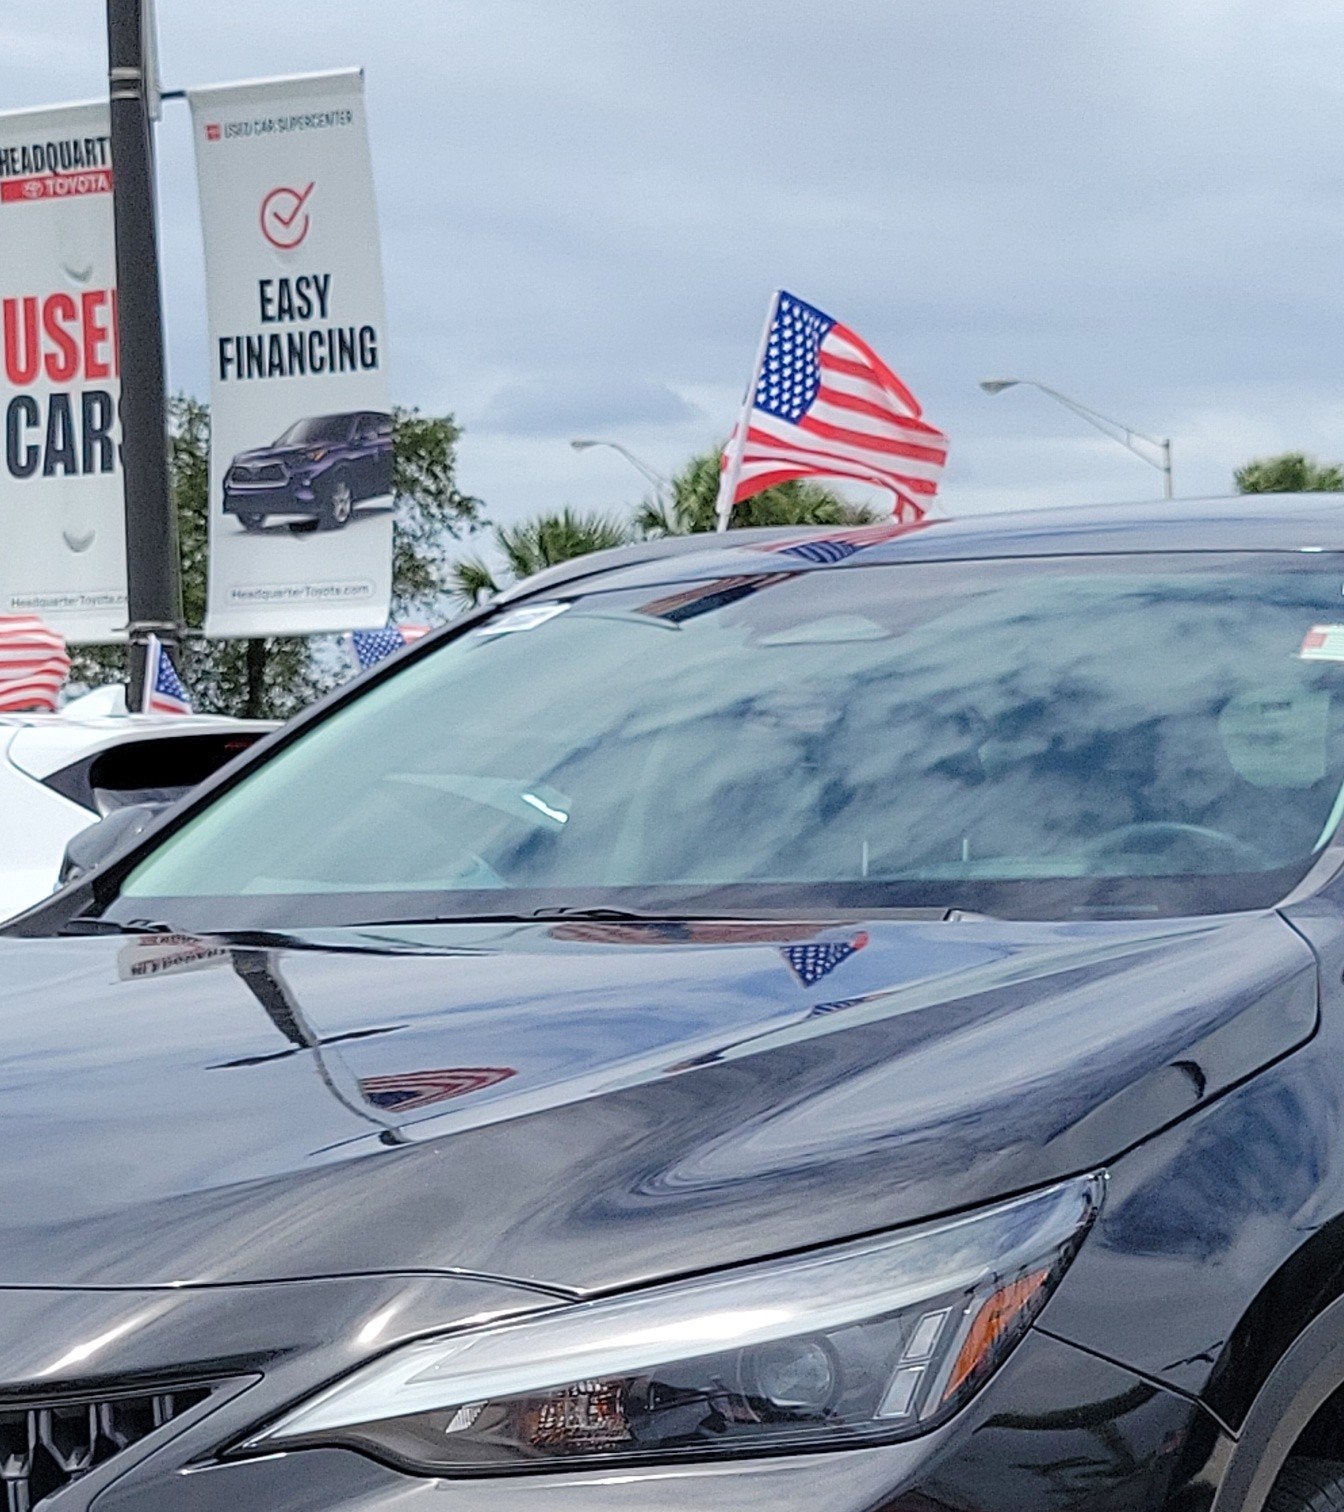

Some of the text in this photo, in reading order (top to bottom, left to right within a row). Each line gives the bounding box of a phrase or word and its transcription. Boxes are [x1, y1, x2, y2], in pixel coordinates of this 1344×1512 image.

[45, 173, 110, 197] TOYOTA
[258, 273, 331, 323] EASY
[2, 289, 120, 386] USE
[218, 325, 378, 381] FINANCING
[6, 390, 125, 479] CAR
